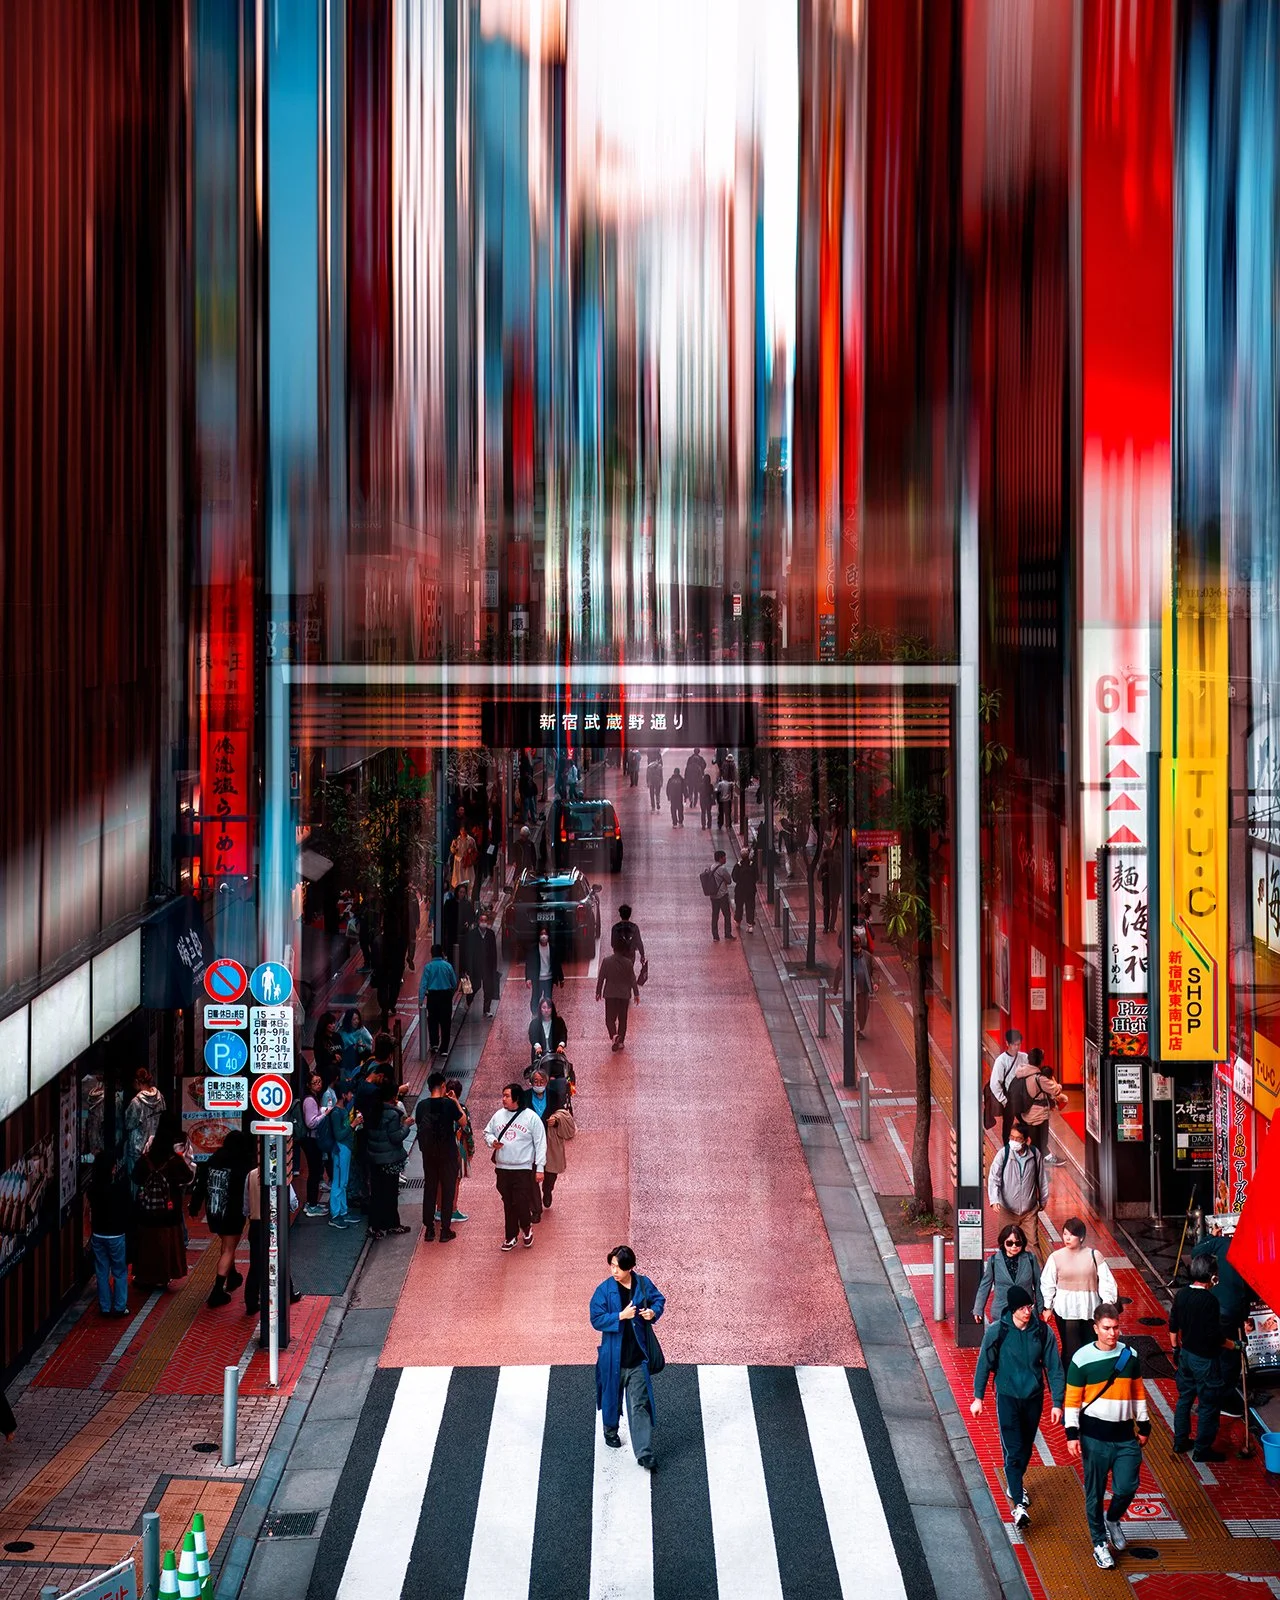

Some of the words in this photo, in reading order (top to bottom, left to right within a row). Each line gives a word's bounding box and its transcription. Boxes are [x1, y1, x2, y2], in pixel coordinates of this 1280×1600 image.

[1096, 675, 1148, 713] 6F
[539, 713, 685, 731] 新宿武蔵野通り
[1111, 944, 1121, 984] らーめん
[1168, 950, 1183, 1051] 新宿駅東南口店
[1187, 968, 1202, 1034] SHOP
[260, 1086, 284, 1107] 30
